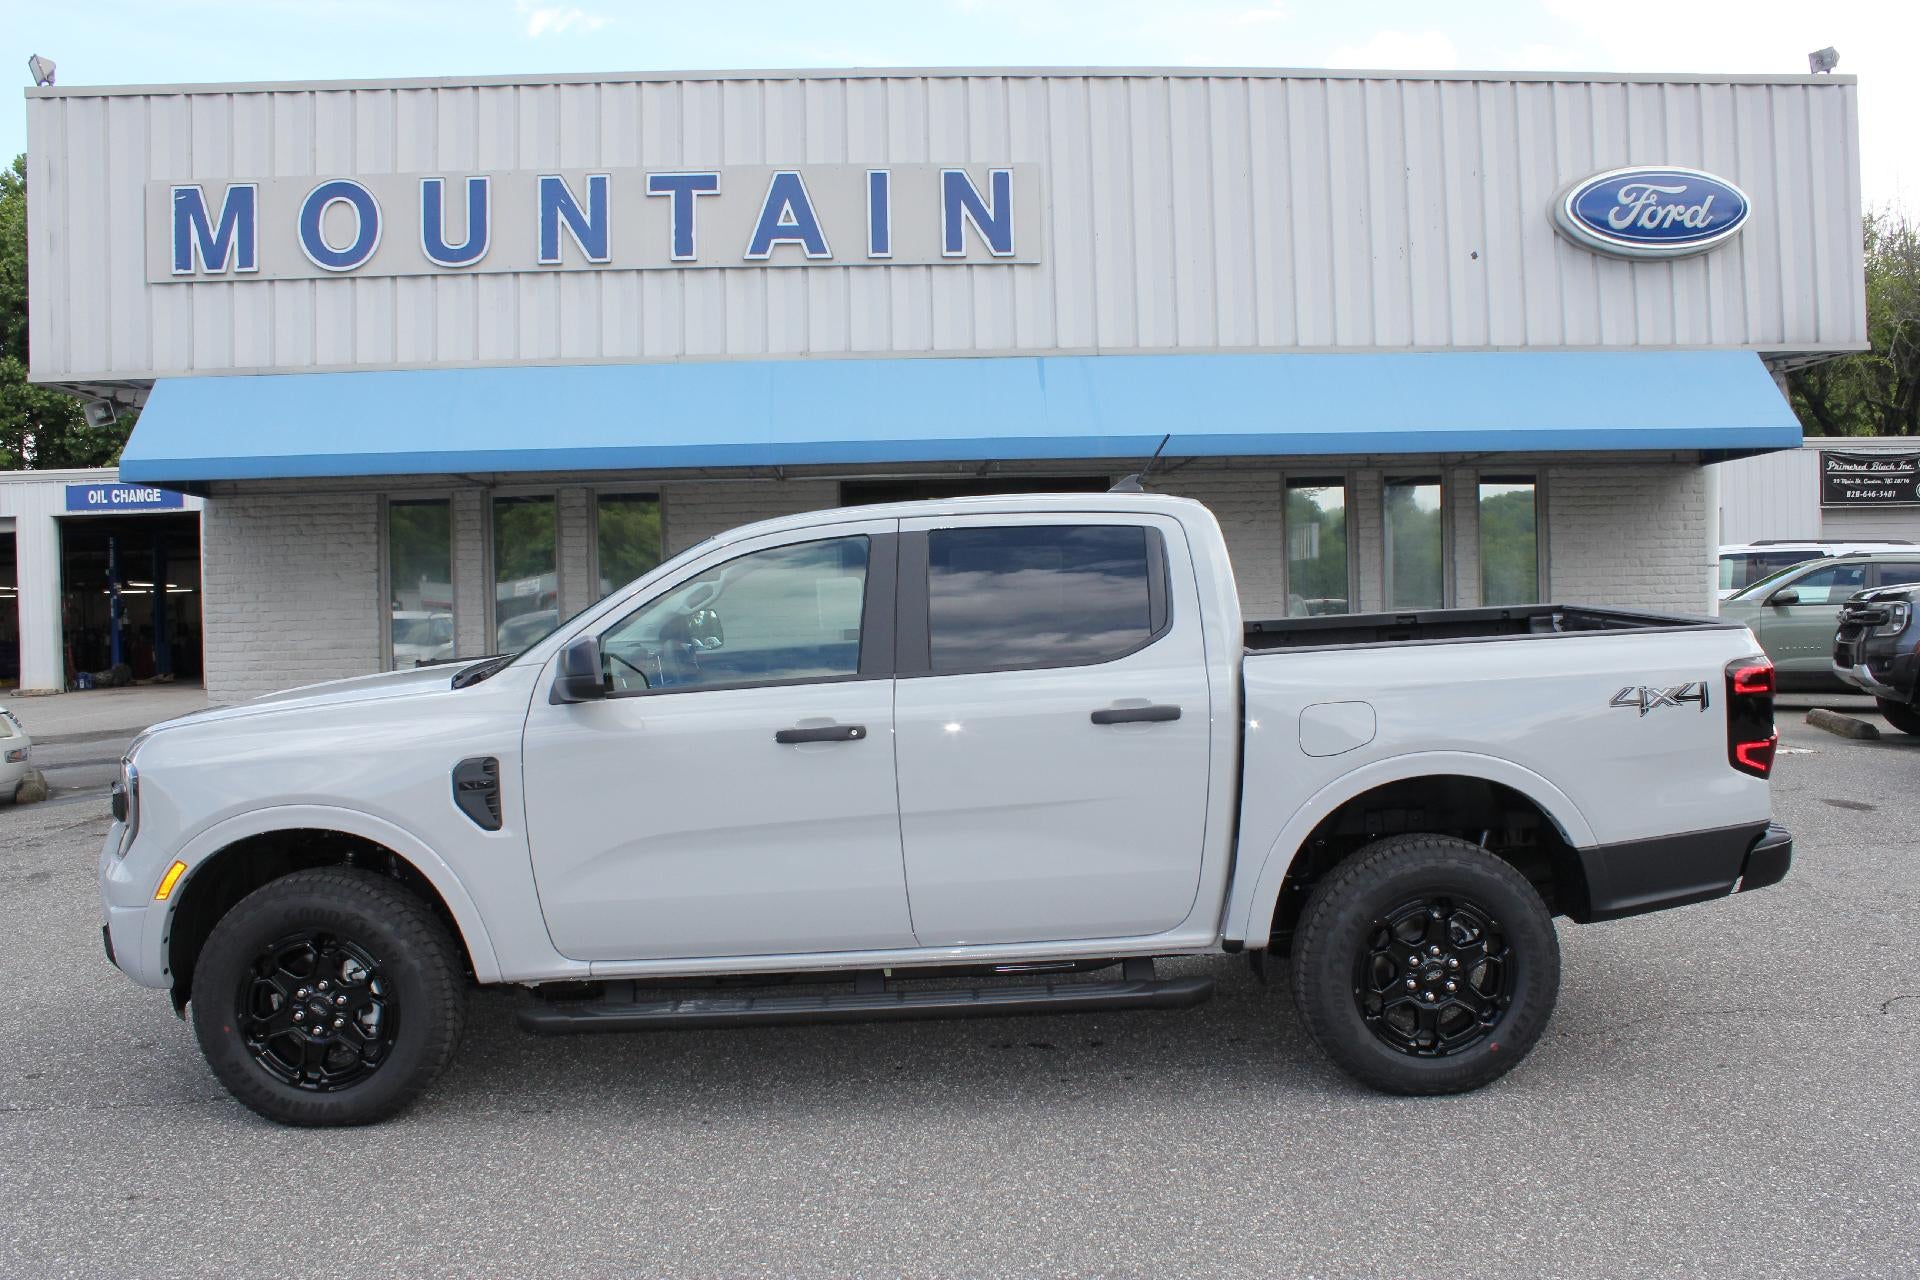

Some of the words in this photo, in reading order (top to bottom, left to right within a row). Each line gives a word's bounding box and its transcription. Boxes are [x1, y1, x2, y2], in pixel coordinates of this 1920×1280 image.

[171, 168, 1015, 275] MOUNTAIN
[1608, 183, 1714, 229] Ford
[1897, 461, 1915, 470] Inc.
[88, 490, 108, 504] OIL
[112, 488, 162, 504] CHANGE
